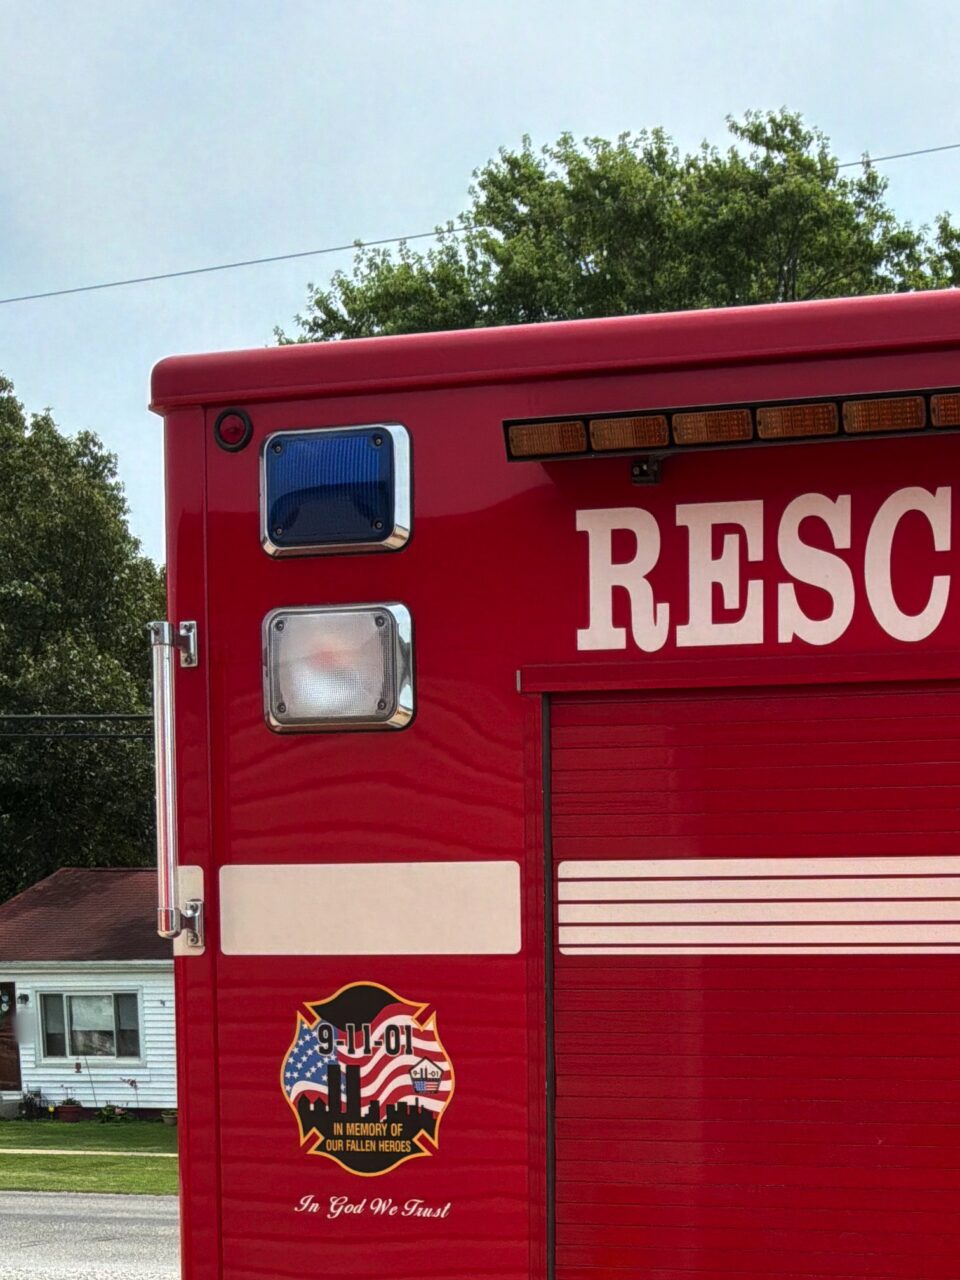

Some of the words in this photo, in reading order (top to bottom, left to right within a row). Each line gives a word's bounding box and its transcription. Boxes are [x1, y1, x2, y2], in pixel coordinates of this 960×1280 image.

[316, 1022, 415, 1056] 9-11-01
[333, 1122, 344, 1136] IN
[346, 1122, 388, 1137] MEMORY
[390, 1122, 404, 1137] OF
[325, 1139, 344, 1152] OUR
[346, 1139, 377, 1152] FALLEN
[378, 1140, 412, 1153] HEROES
[294, 1194, 320, 1213] In
[326, 1195, 368, 1220] God
[369, 1197, 399, 1216] We
[401, 1198, 452, 1219] Trust
